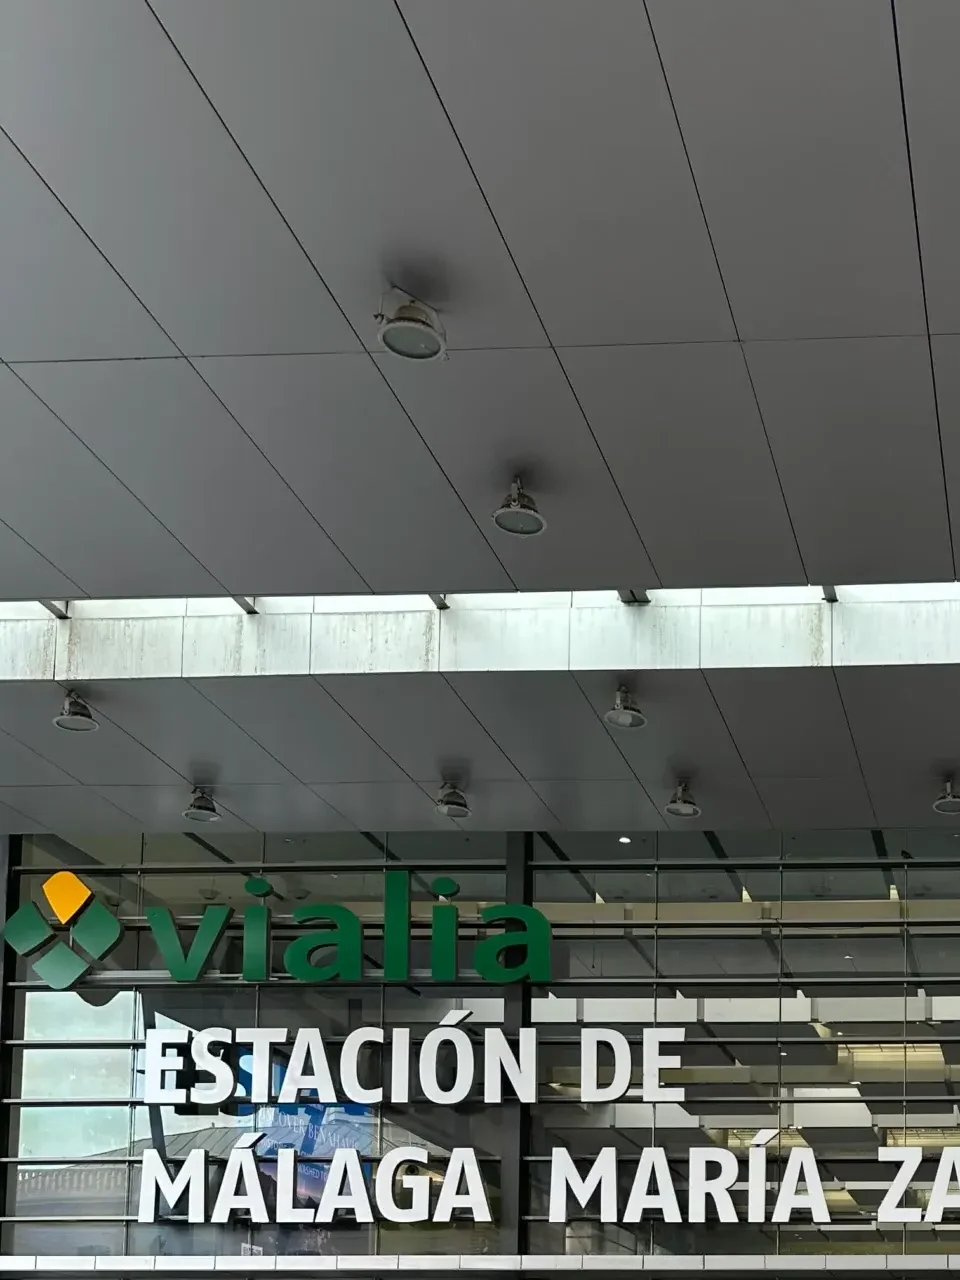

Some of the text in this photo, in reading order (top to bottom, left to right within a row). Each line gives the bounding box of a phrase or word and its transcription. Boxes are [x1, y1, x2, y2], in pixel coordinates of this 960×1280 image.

[146, 870, 552, 982] vialia
[143, 1009, 686, 1104] ESTACIÓN DE
[137, 1132, 493, 1224] MÁLAGA
[549, 1129, 831, 1223] MARÍA
